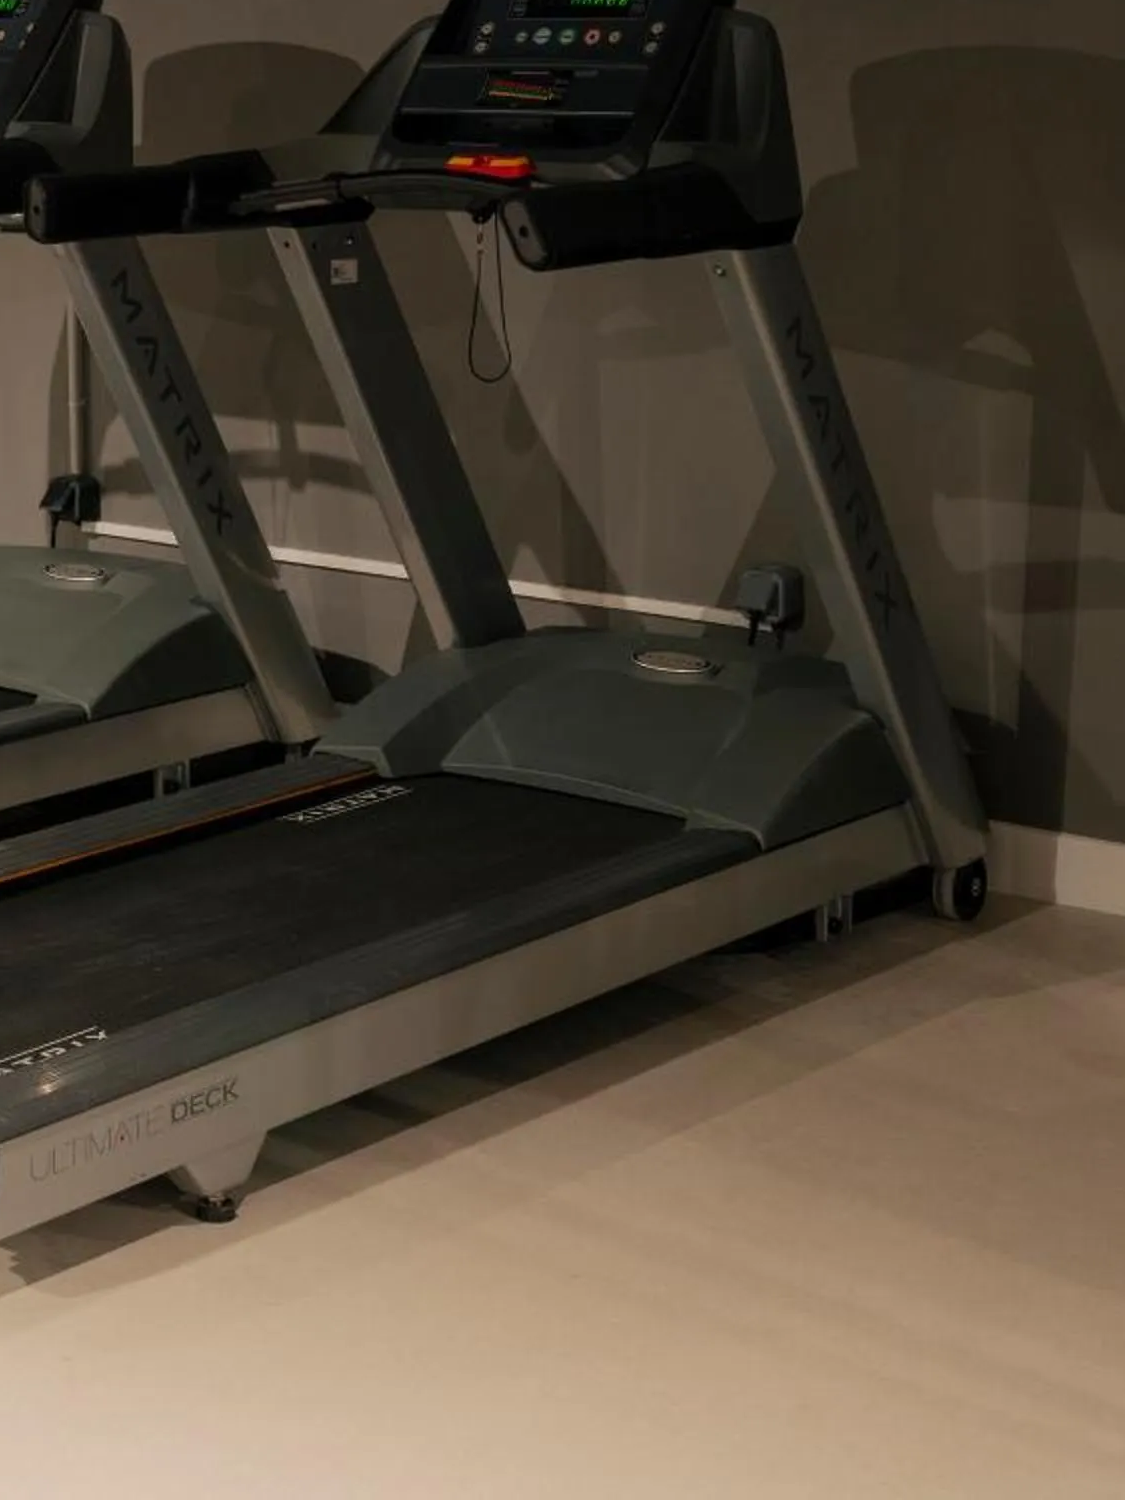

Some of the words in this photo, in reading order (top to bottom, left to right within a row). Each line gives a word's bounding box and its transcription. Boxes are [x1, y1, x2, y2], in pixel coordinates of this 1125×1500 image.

[110, 267, 233, 537] MATRIX
[785, 315, 897, 632] MATRIX
[29, 1104, 167, 1181] ULTIMATE
[170, 1075, 240, 1125] DECK
